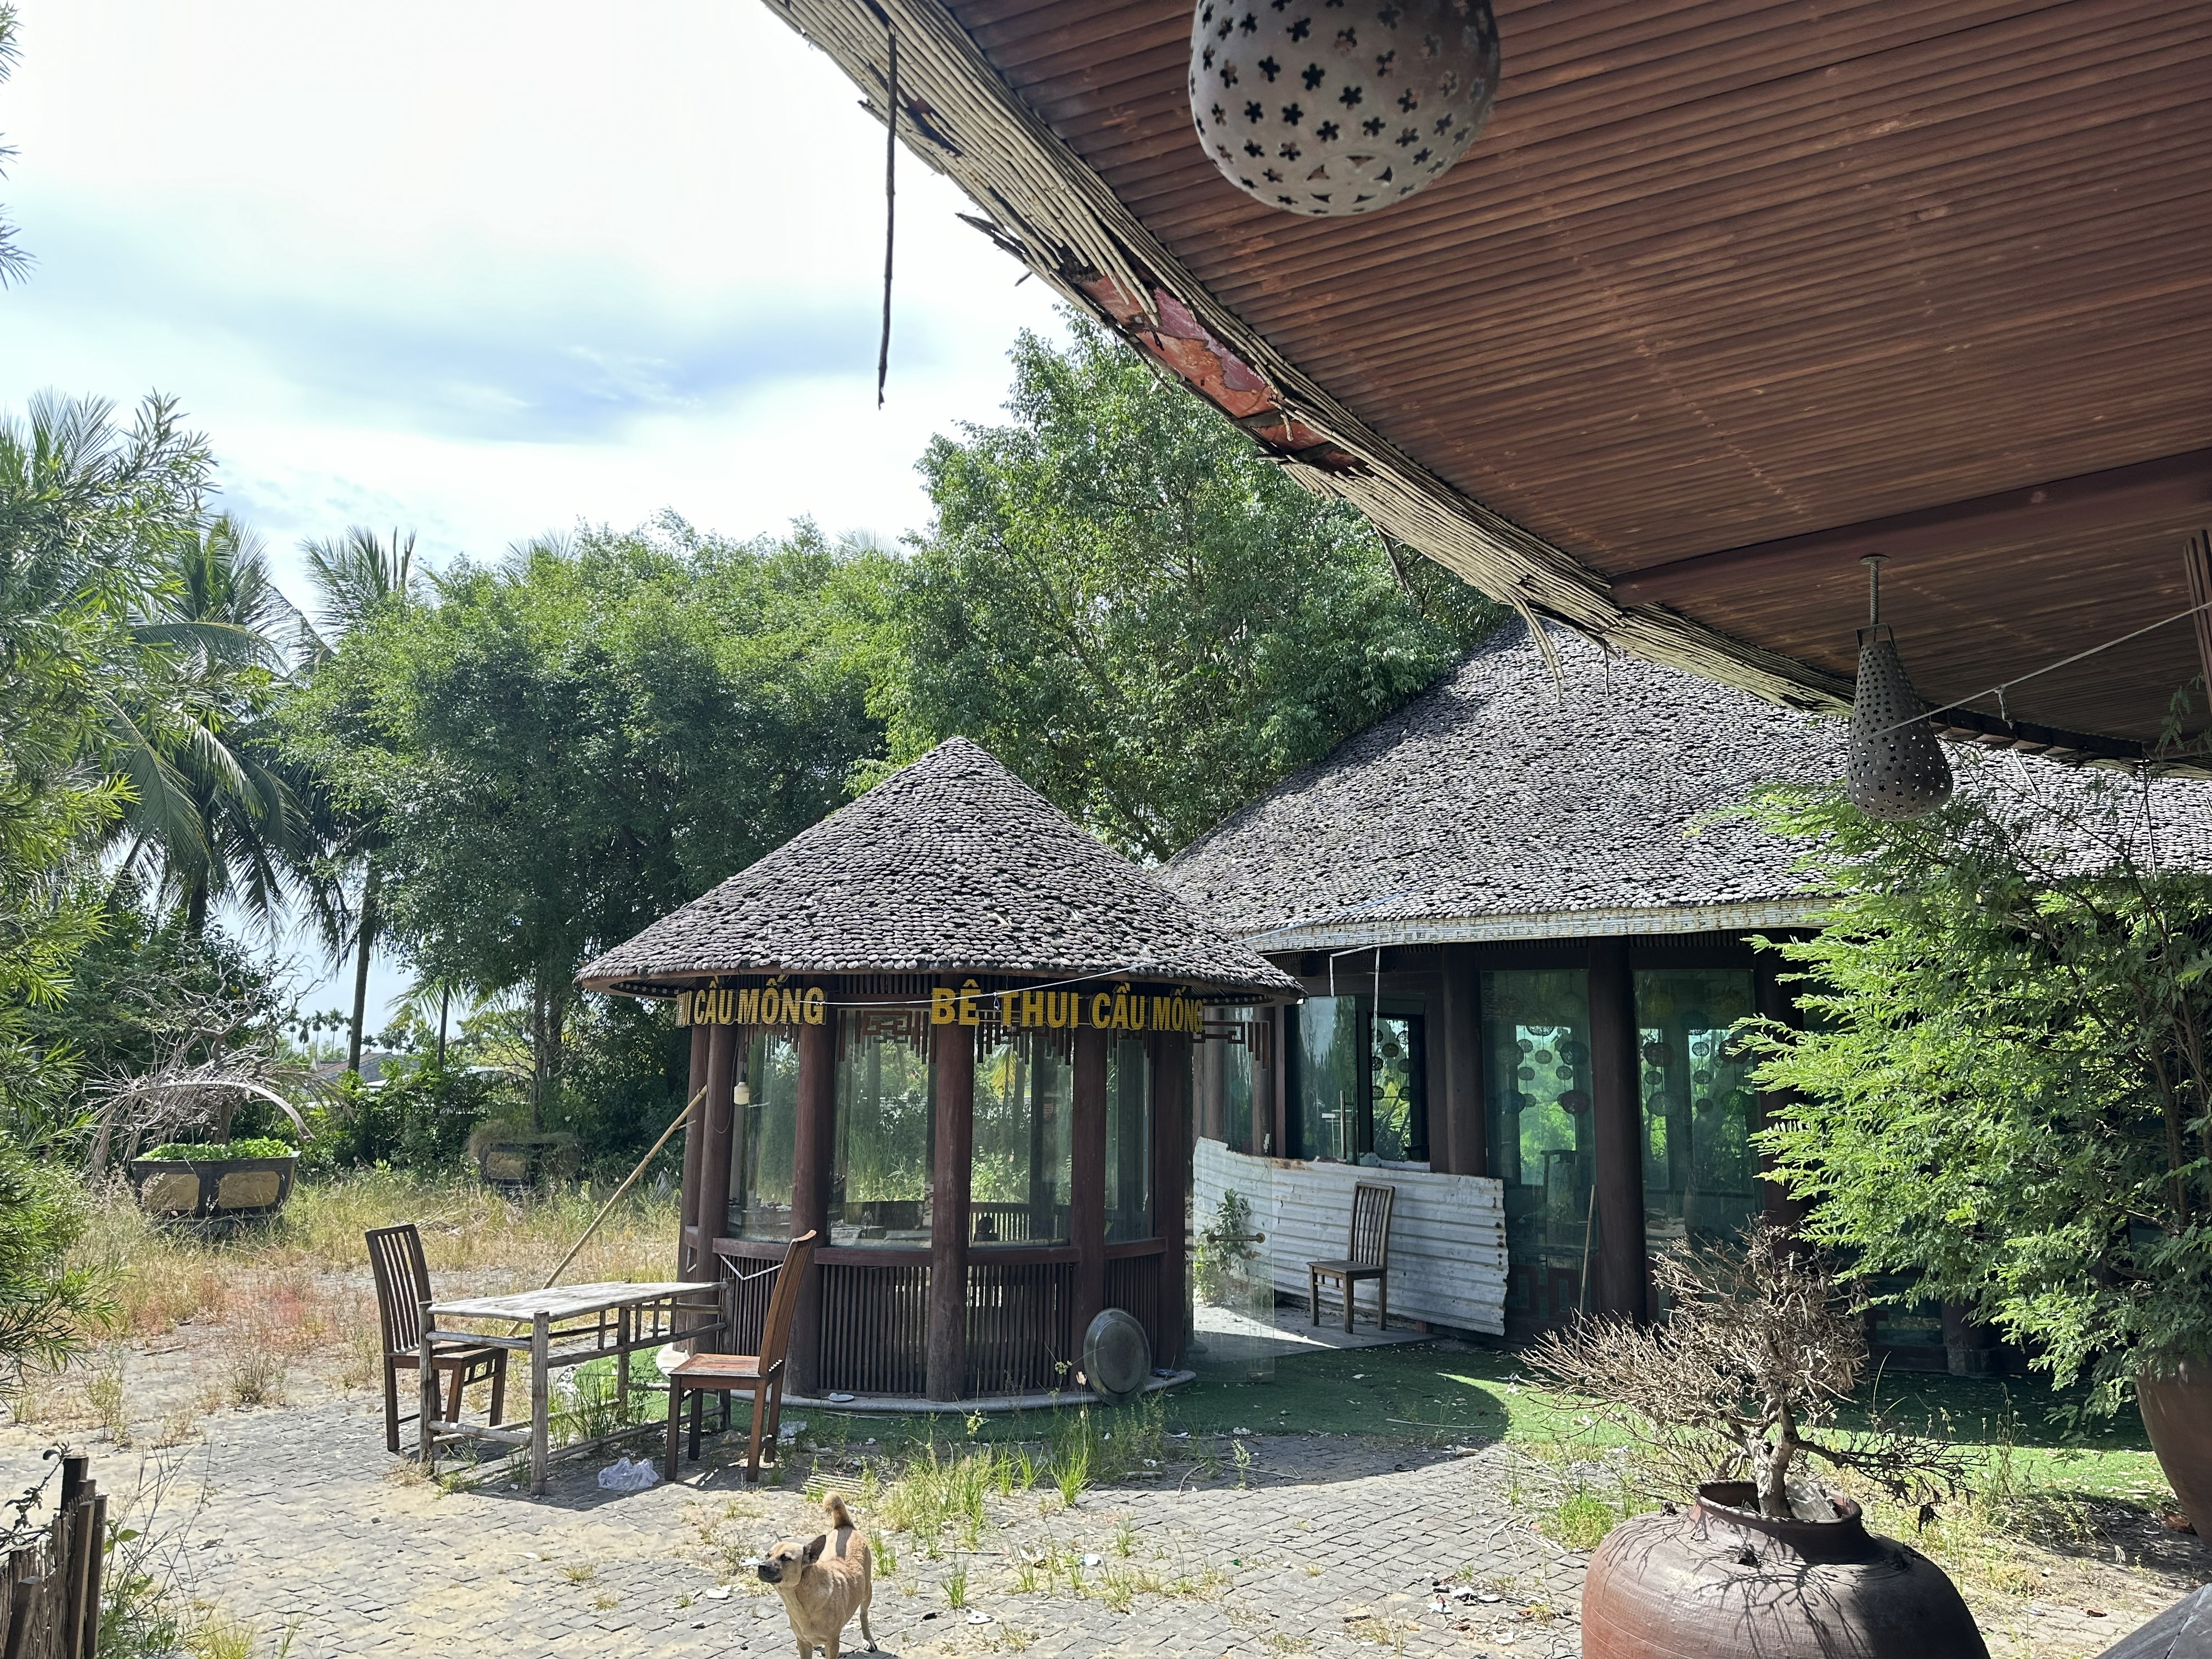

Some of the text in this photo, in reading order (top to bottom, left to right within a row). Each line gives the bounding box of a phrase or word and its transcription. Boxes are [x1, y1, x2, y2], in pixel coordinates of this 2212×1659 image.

[693, 975, 733, 1024] CẦU
[737, 974, 825, 1024] MỐNG
[931, 978, 1203, 1032] BÊ THUI CẦU MỐNG
